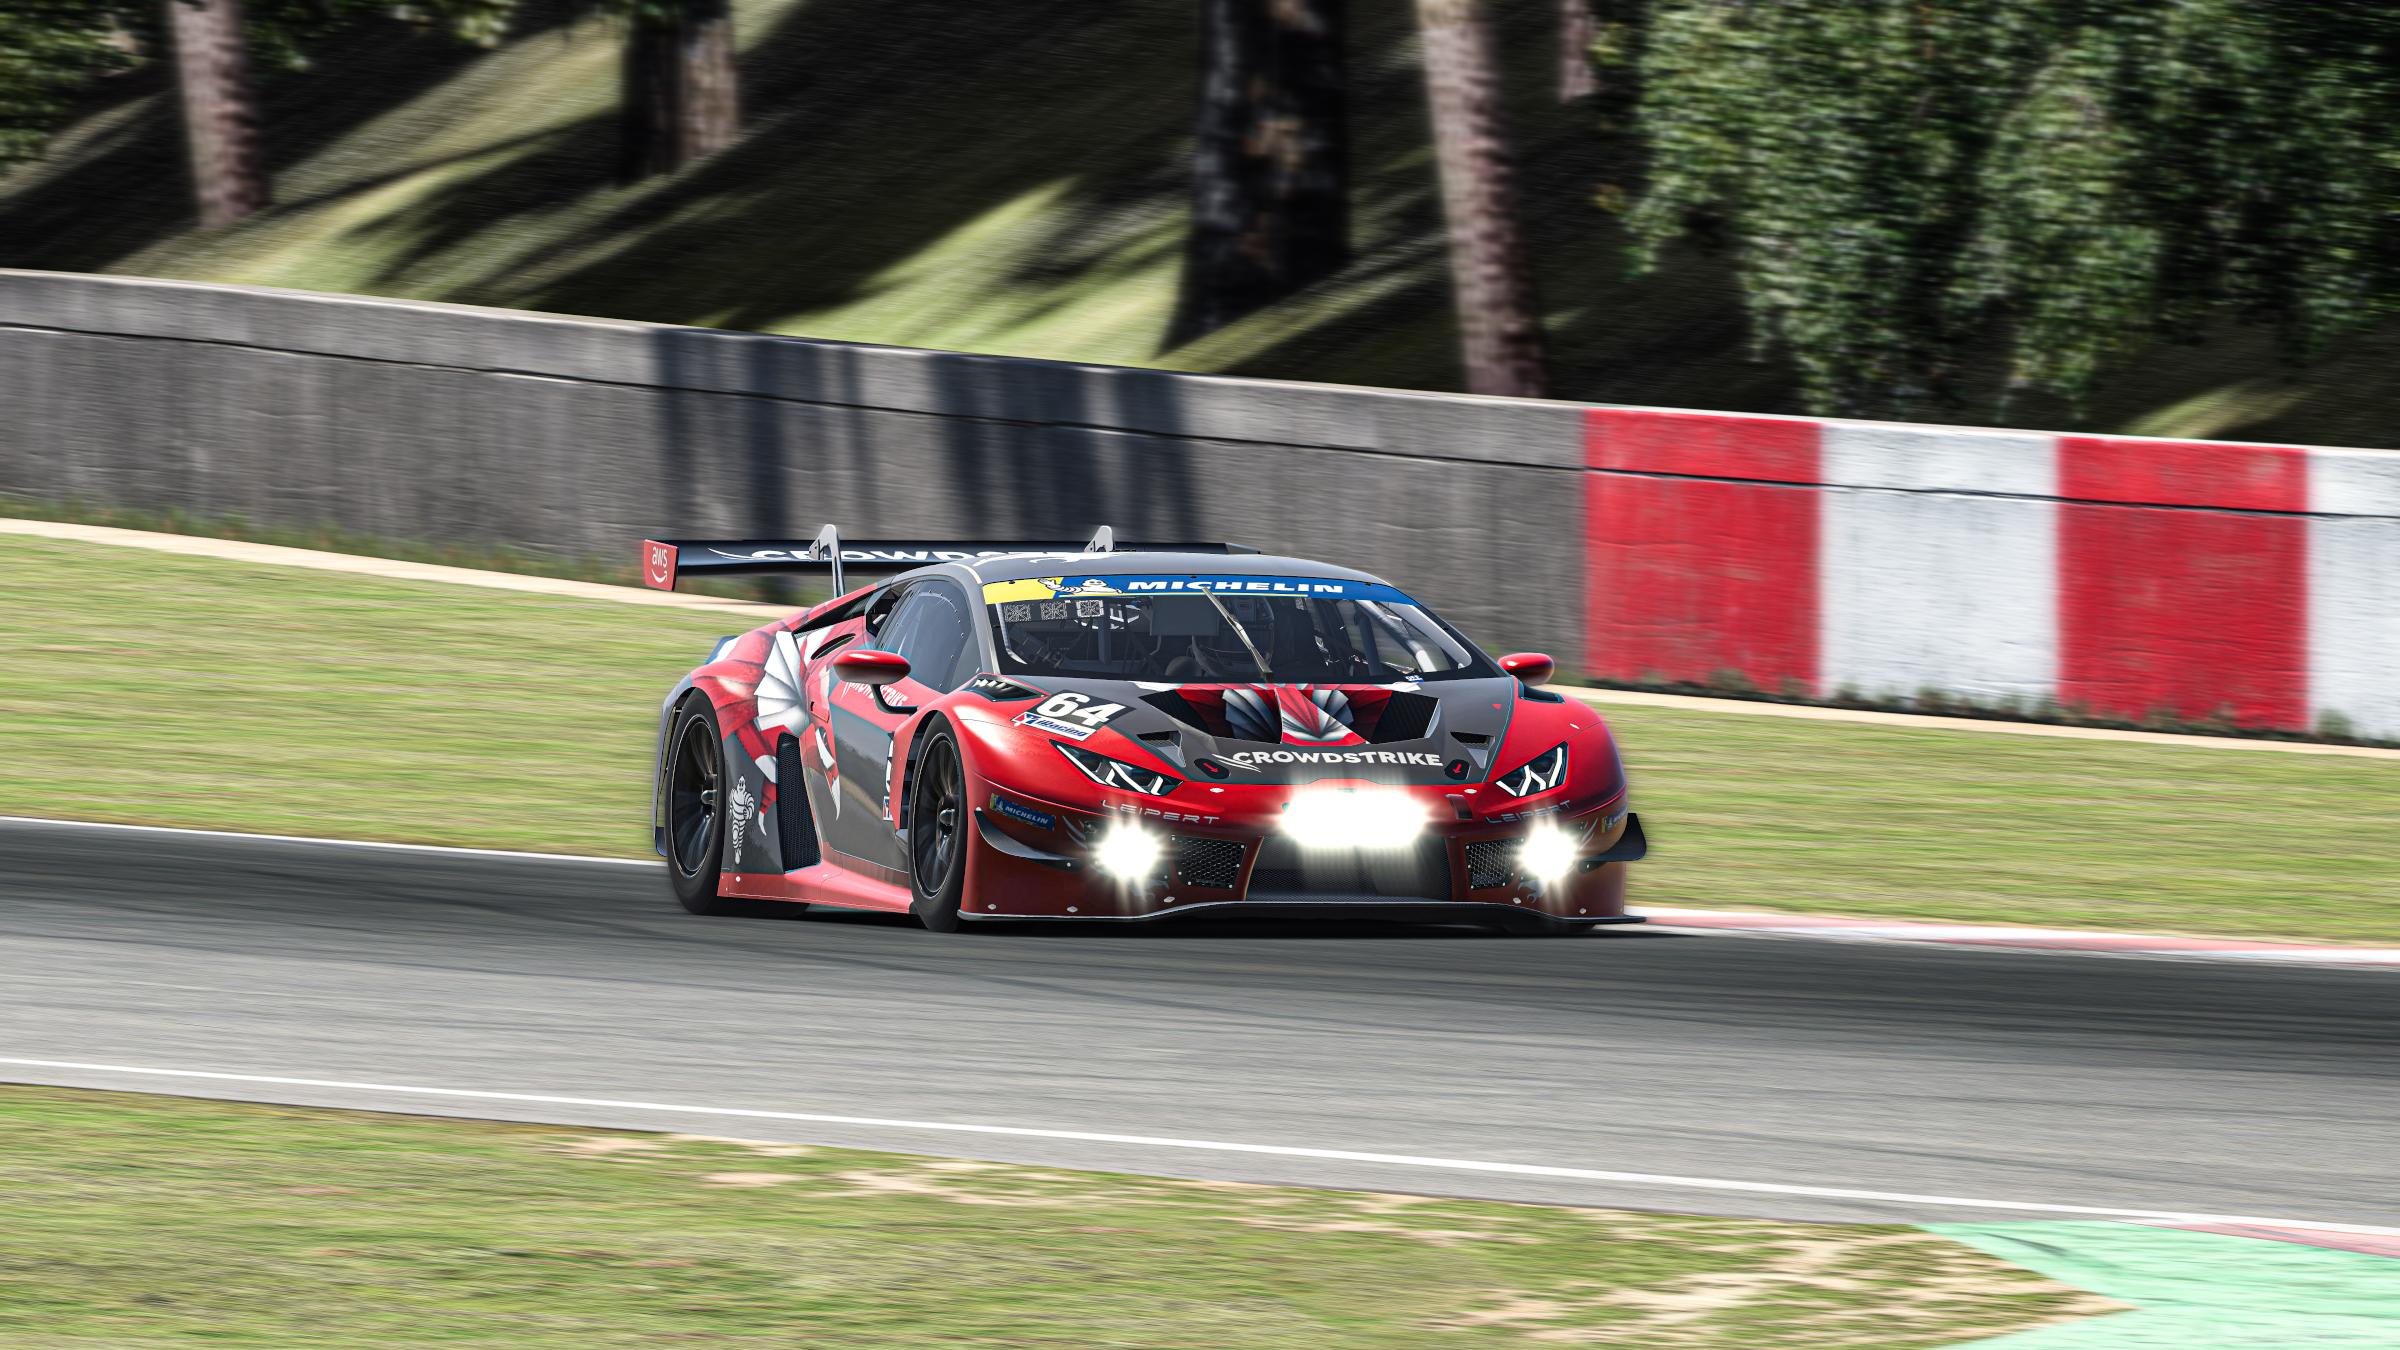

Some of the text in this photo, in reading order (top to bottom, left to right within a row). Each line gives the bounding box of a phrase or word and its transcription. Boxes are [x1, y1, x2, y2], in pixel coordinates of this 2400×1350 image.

[652, 546, 668, 568] aws
[1128, 581, 1344, 594] MICHELIN
[1036, 692, 1127, 727] 64
[1036, 719, 1089, 737] iRacing
[1231, 750, 1444, 767] CROWDSTRIKE
[1004, 805, 1049, 825] MICHELIN
[1101, 799, 1220, 825] LEIPERT
